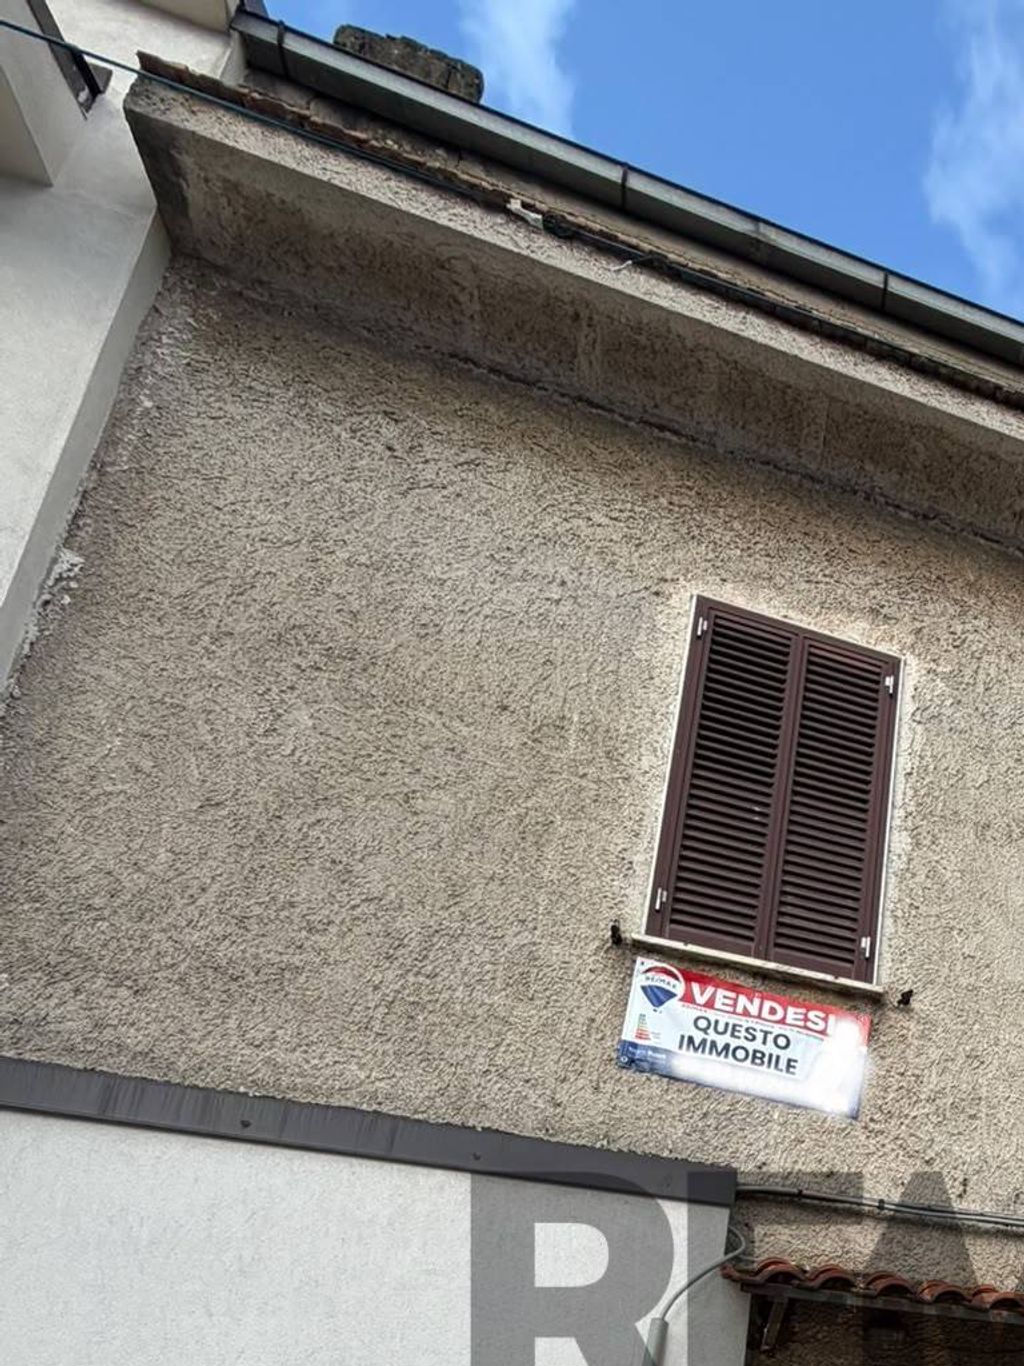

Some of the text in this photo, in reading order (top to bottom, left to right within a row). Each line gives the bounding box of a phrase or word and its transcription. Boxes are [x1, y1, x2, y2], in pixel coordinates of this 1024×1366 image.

[690, 981, 836, 1036] VENDESI
[693, 1015, 791, 1050] QUESTO
[678, 1034, 799, 1075] IMMOBILE
